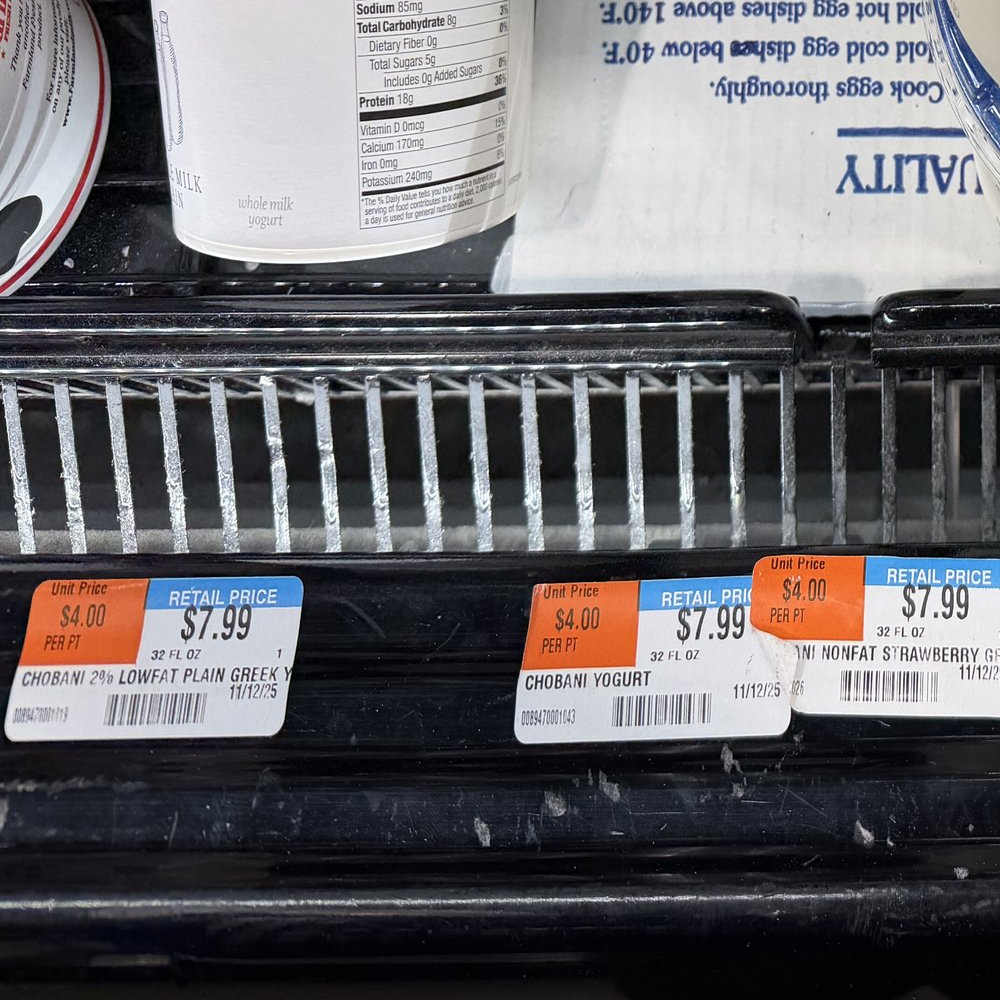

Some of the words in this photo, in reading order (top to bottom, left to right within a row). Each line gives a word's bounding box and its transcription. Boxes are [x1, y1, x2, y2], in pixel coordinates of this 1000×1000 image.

[674, 1, 733, 17] above
[742, 1, 805, 18] dishes
[813, 0, 849, 18] egg
[856, 2, 890, 19] hot
[710, 76, 829, 103] thoroughly.
[837, 77, 883, 97] eggs
[890, 79, 944, 103] Cook
[359, 95, 395, 108] Protein
[397, 93, 414, 106] 18g
[237, 194, 268, 211] whole
[269, 196, 294, 211] milk
[247, 212, 283, 229] yogurt
[169, 589, 224, 606] RETAIL
[230, 589, 277, 604] PRICE
[544, 586, 566, 599] Unit
[571, 586, 598, 598] Price
[783, 578, 826, 602] $4.00
[902, 583, 969, 622] $7.99
[60, 604, 106, 628] $4.00
[181, 604, 251, 643] $7.99
[556, 607, 600, 632] $4.00
[677, 604, 745, 644] $7.99
[822, 645, 876, 661] NONFAT
[882, 646, 979, 663] STRAWBERRY
[22, 671, 86, 686] CHOBANI
[90, 671, 113, 685] 2%
[119, 669, 176, 684] LOWFAT
[183, 668, 224, 683] PLAIN
[230, 667, 277, 682] GREEK
[525, 674, 587, 690] CHOBANI
[594, 671, 651, 688] YOGURT
[230, 684, 277, 700] 11/12/25
[734, 682, 781, 699] 11/12/25
